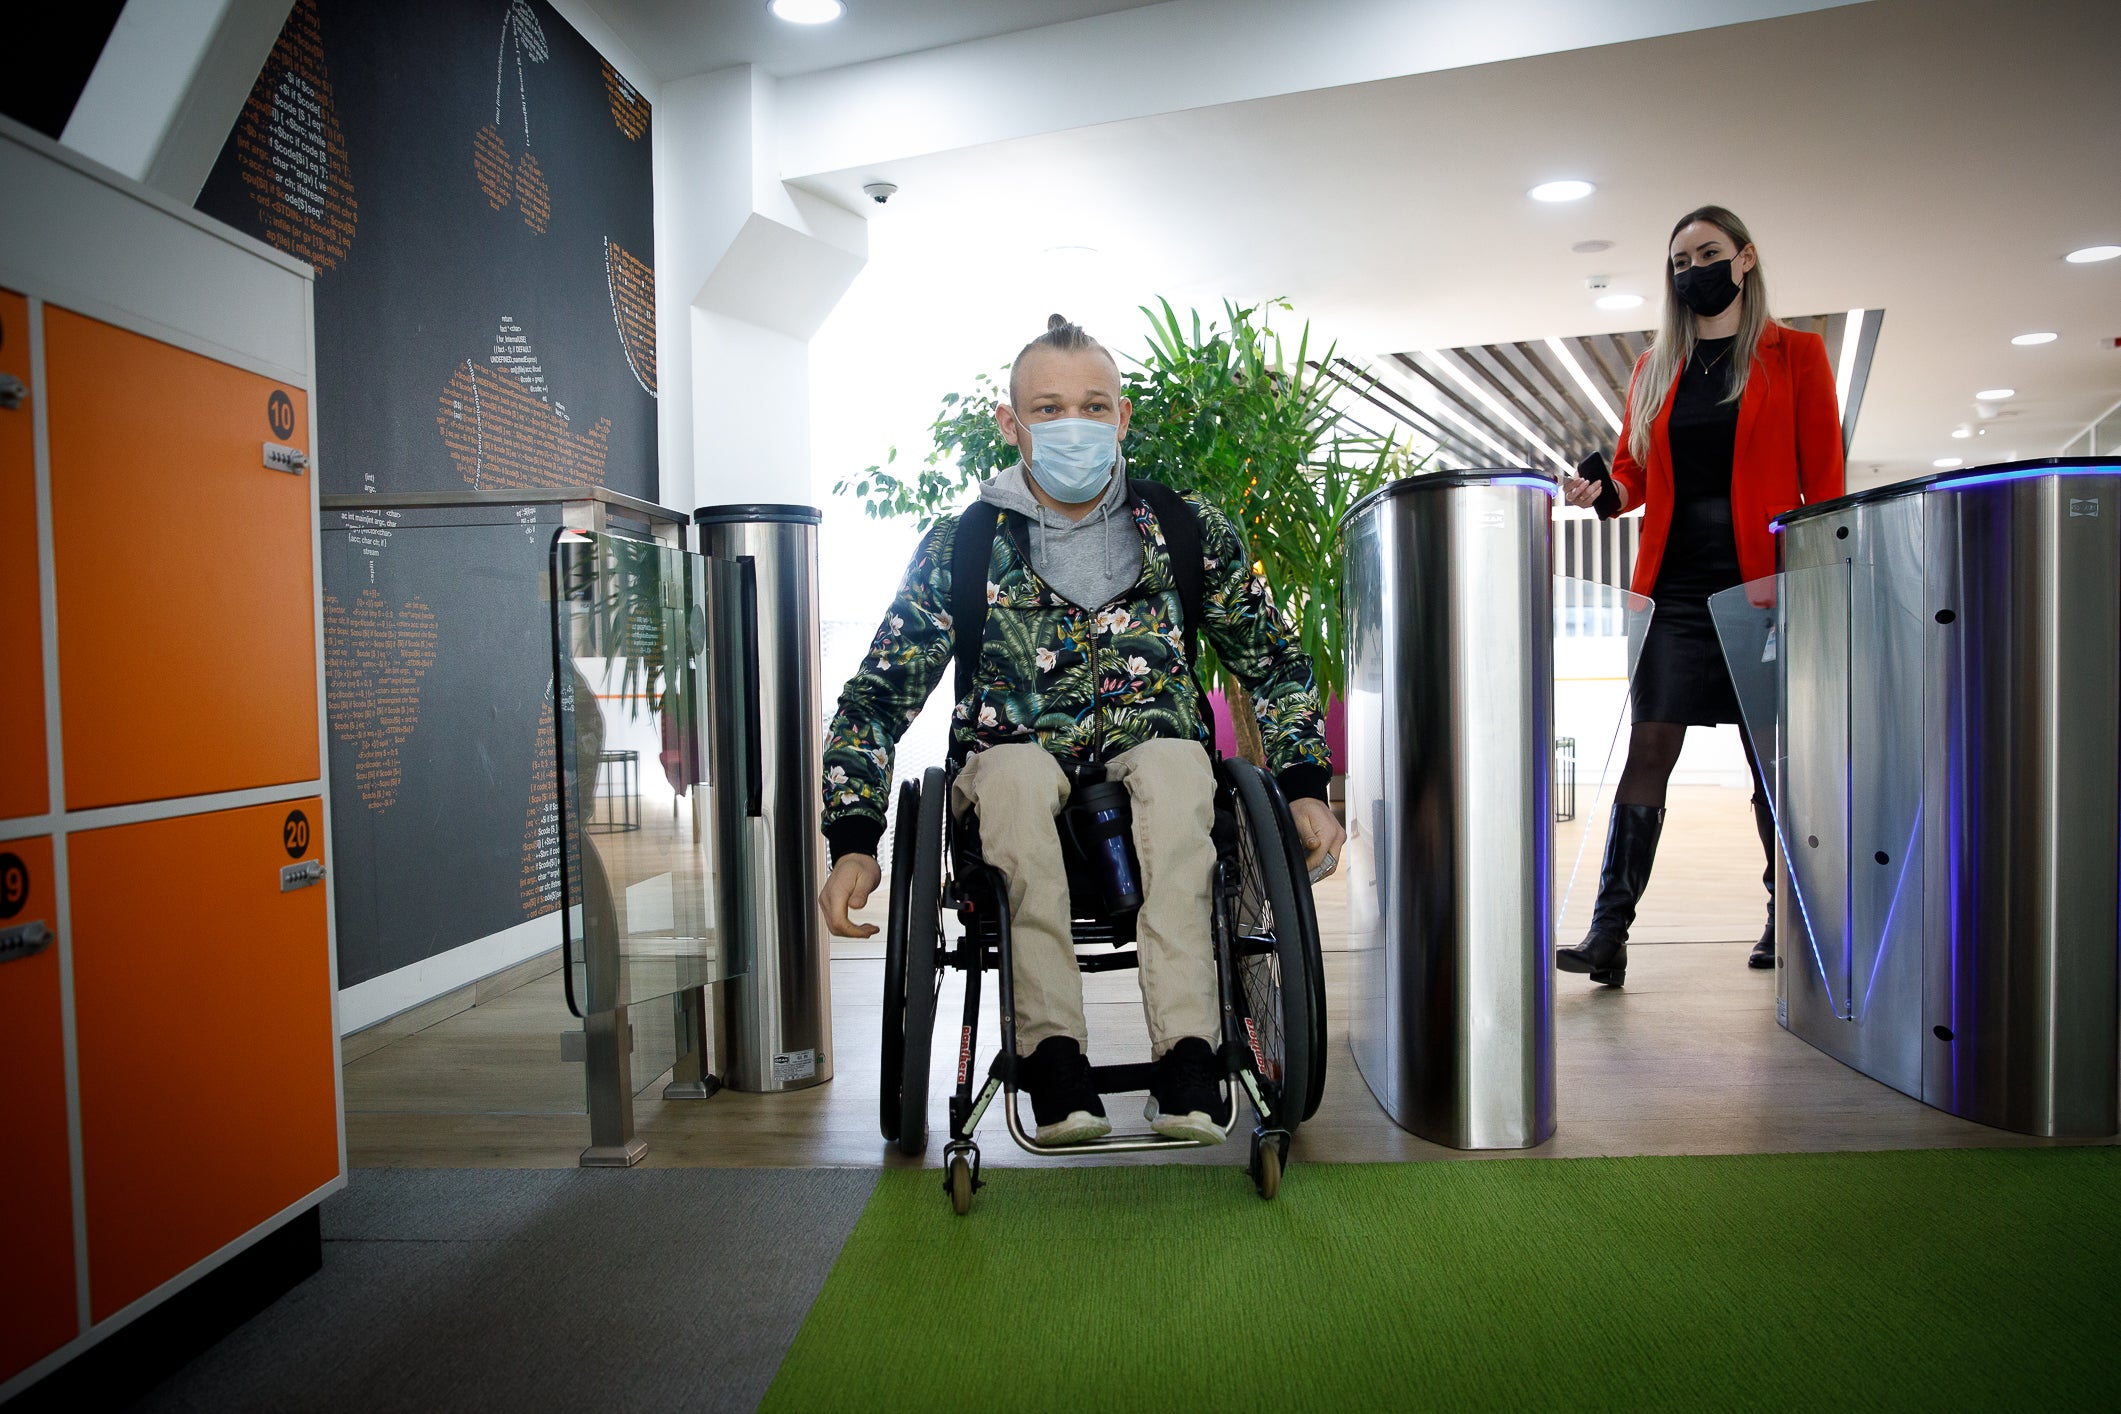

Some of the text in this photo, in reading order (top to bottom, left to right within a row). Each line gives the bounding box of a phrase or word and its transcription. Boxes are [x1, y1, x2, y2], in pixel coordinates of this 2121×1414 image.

[308, 130, 326, 148] while
[271, 400, 292, 431] 10
[287, 820, 307, 848] 20
[0, 866, 24, 905] 9
[958, 1026, 971, 1084] panthera
[1244, 1018, 1265, 1074] panthera
